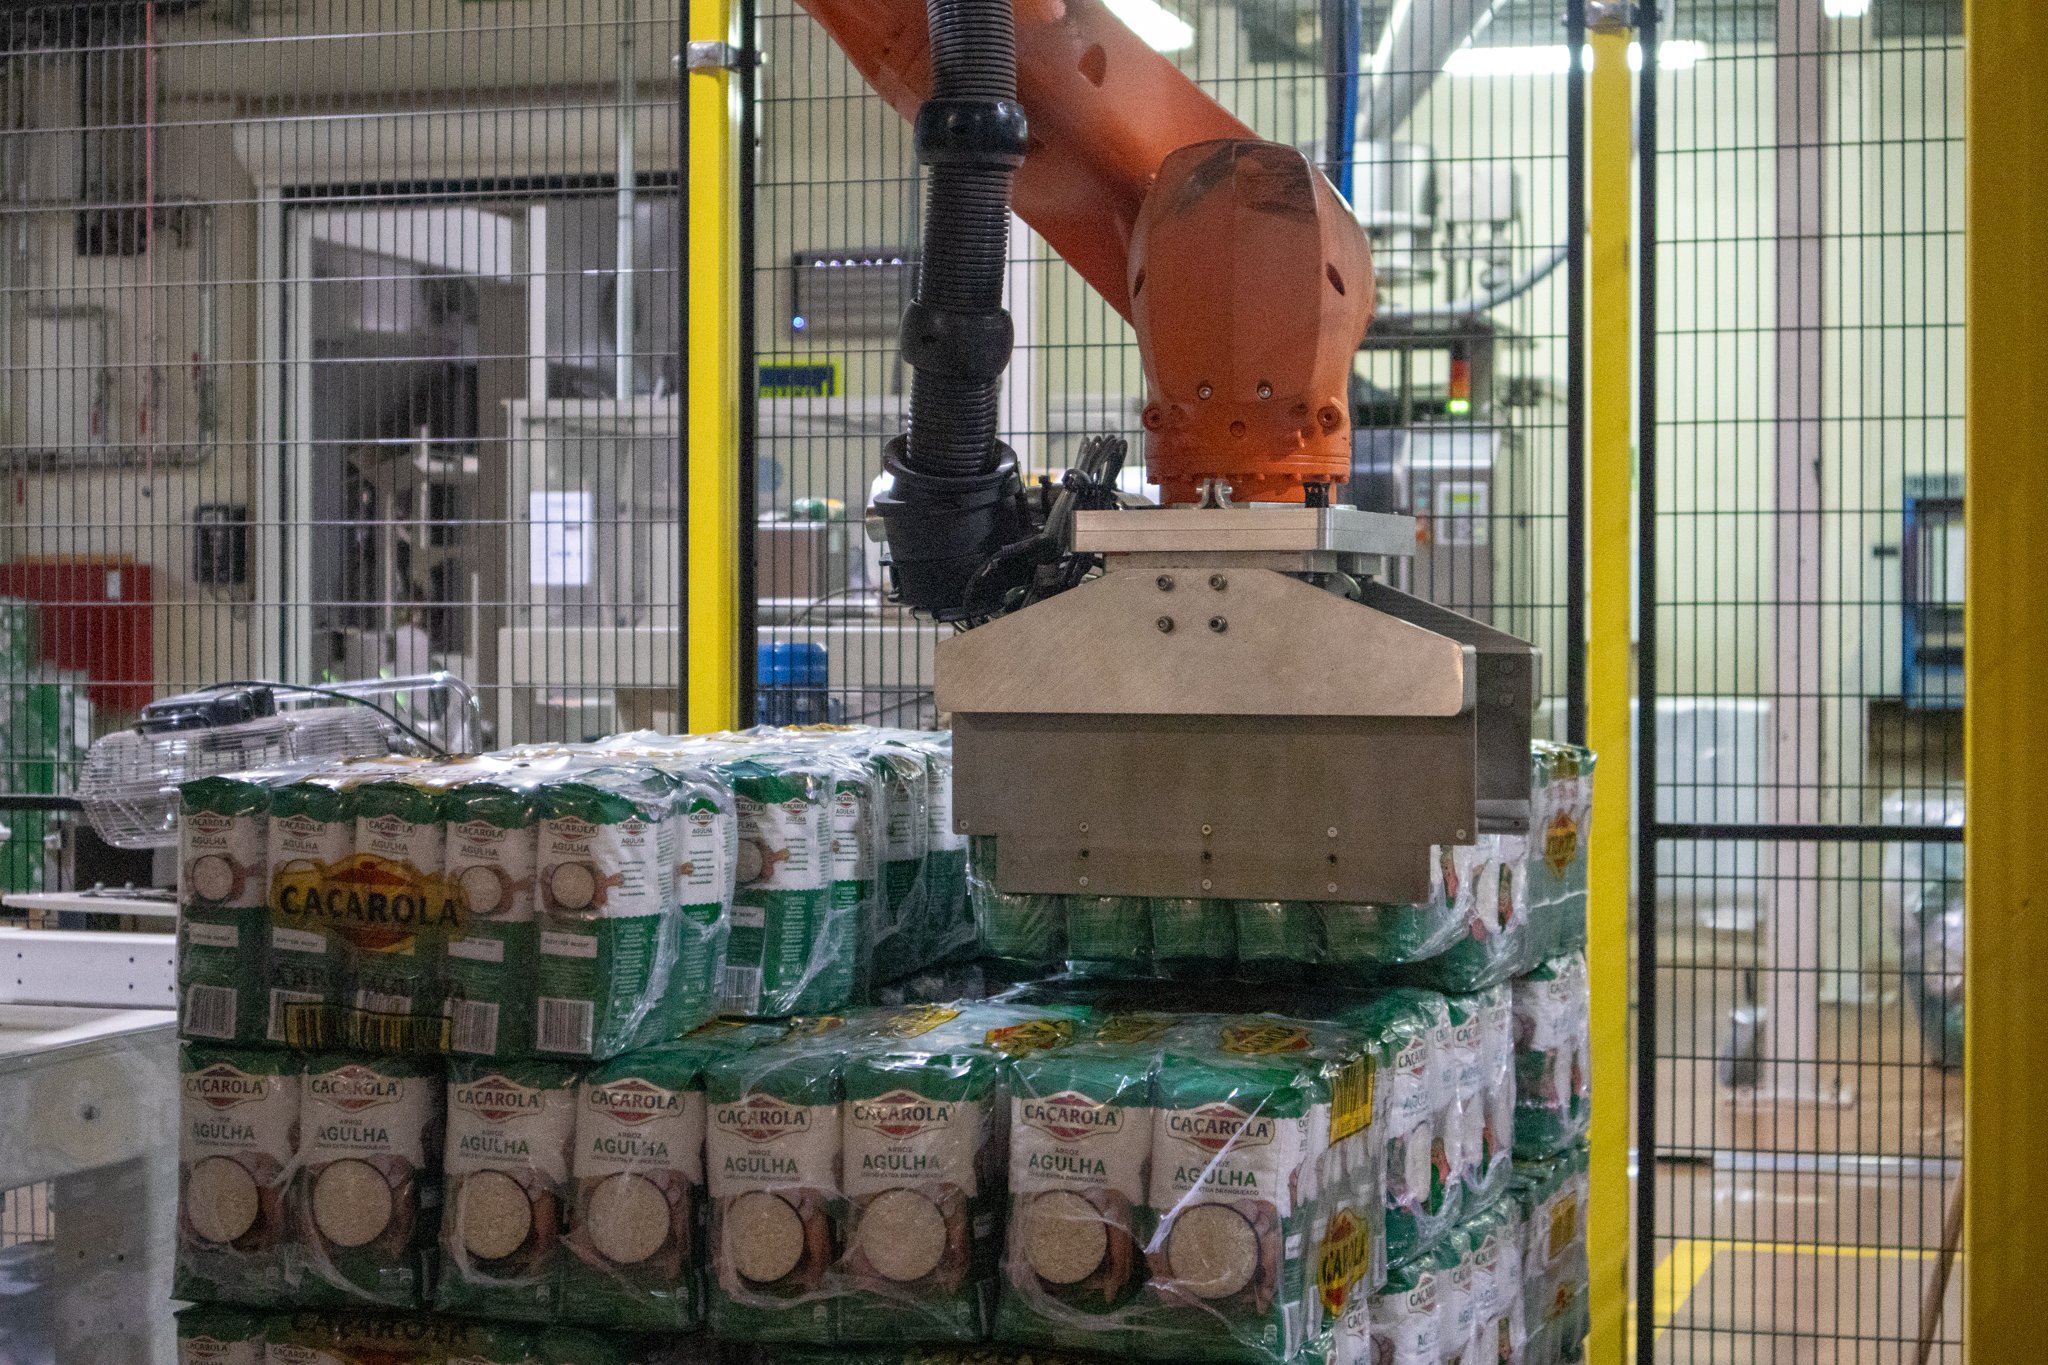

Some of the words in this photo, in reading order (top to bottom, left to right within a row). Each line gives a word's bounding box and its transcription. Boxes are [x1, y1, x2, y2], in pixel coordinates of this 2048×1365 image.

[192, 836, 227, 846] AGULHA
[282, 839, 319, 850] AGULHA
[371, 839, 409, 852] AGULHA
[551, 842, 591, 853] AGULHA
[461, 845, 498, 857] AGULHA
[316, 1124, 390, 1143] AGULHA
[460, 1134, 530, 1156] AGULHA
[592, 1136, 669, 1158] AGULHA
[1054, 1146, 1080, 1156] ARROZ
[724, 1155, 799, 1174] AGULHA
[862, 1153, 941, 1171] AGULHA
[1028, 1152, 1107, 1176] AGULHA
[1174, 1165, 1258, 1188] AGULHA
[1215, 1186, 1260, 1197] BRANQUEADO
